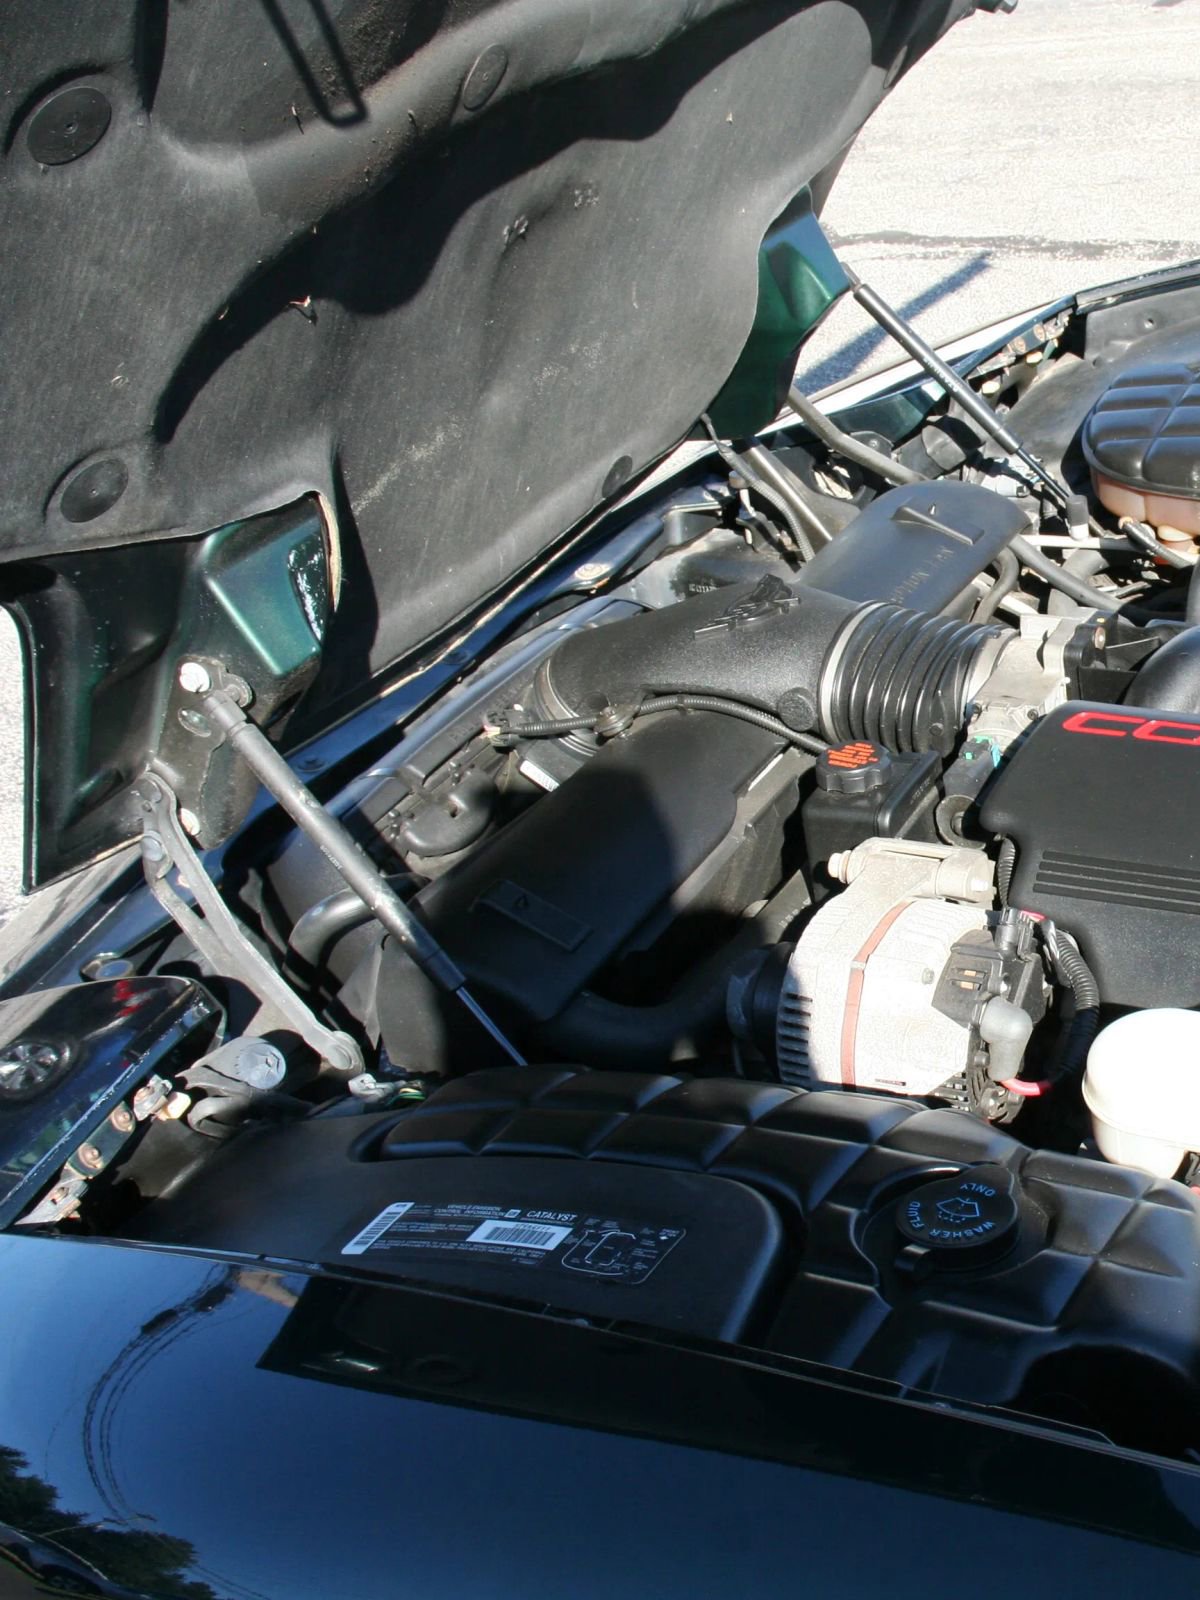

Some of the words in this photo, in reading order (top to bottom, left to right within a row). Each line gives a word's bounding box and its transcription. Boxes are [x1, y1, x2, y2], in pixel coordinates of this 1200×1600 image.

[959, 1182, 995, 1197] ONLY
[525, 1209, 578, 1222] CATALYST
[906, 1201, 925, 1229] FLUID
[929, 1220, 995, 1238] WASHER
